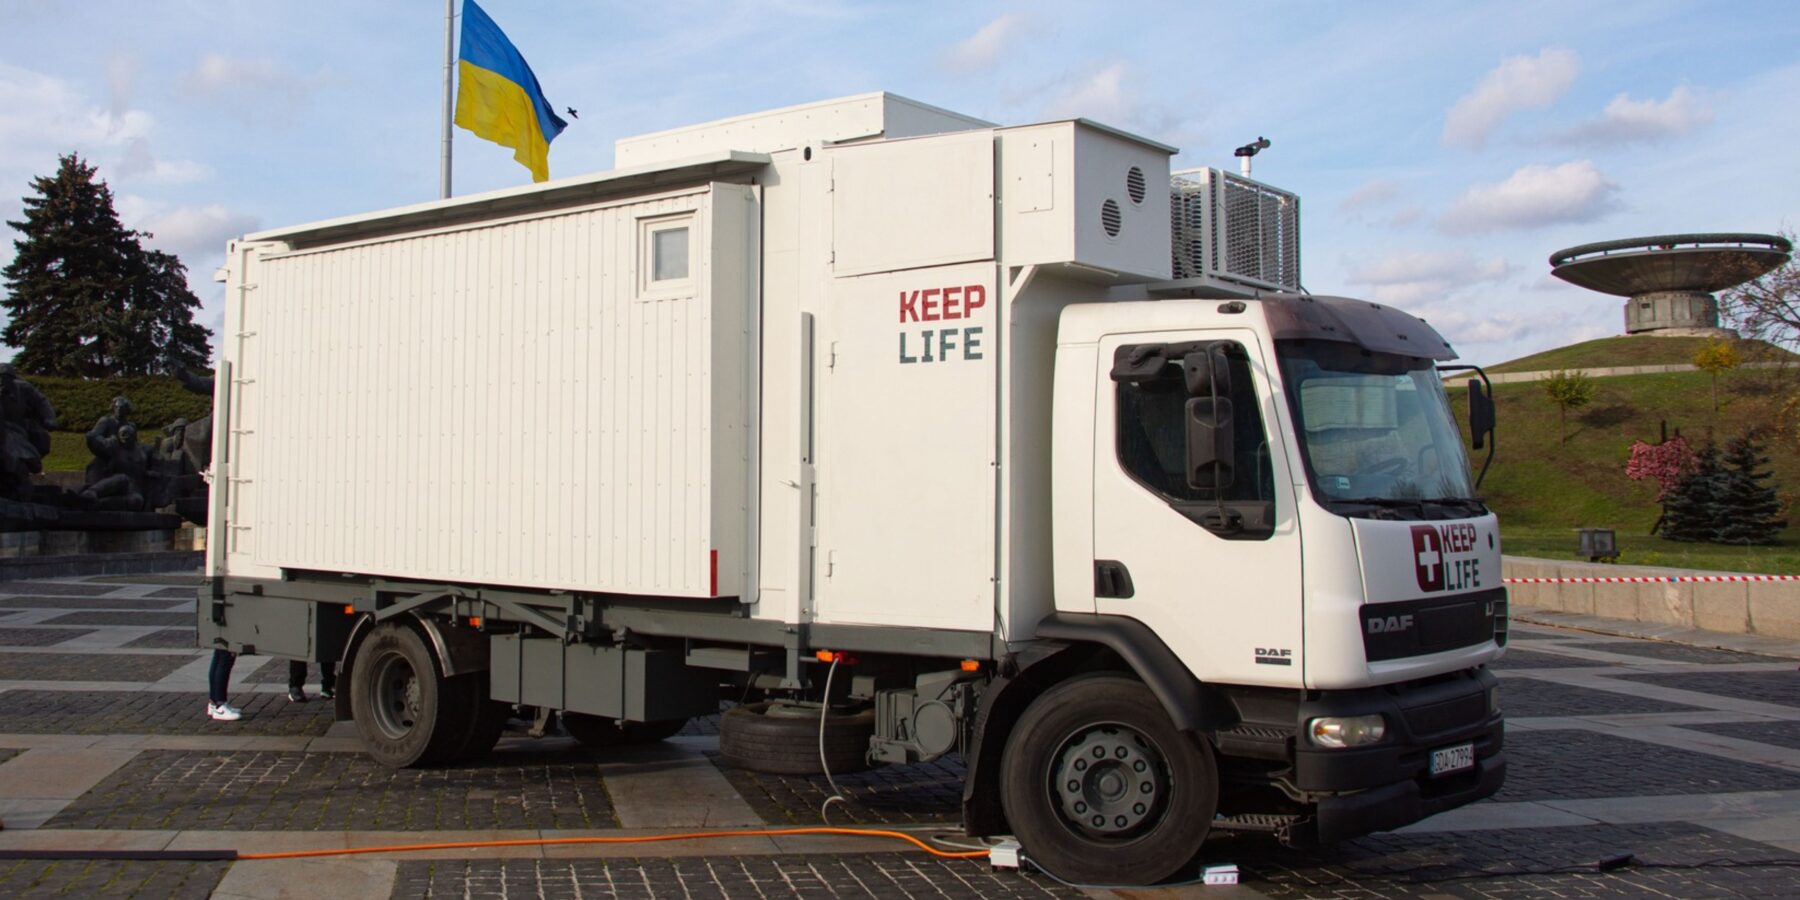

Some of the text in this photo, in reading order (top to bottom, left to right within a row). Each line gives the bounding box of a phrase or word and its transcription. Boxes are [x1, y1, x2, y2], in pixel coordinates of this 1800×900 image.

[899, 285, 986, 323] KEEP
[899, 327, 983, 363] LIFE
[1440, 523, 1477, 553] KEEP
[1445, 559, 1480, 590] LIFE
[1367, 614, 1414, 634] DAF
[1255, 648, 1292, 657] DAF
